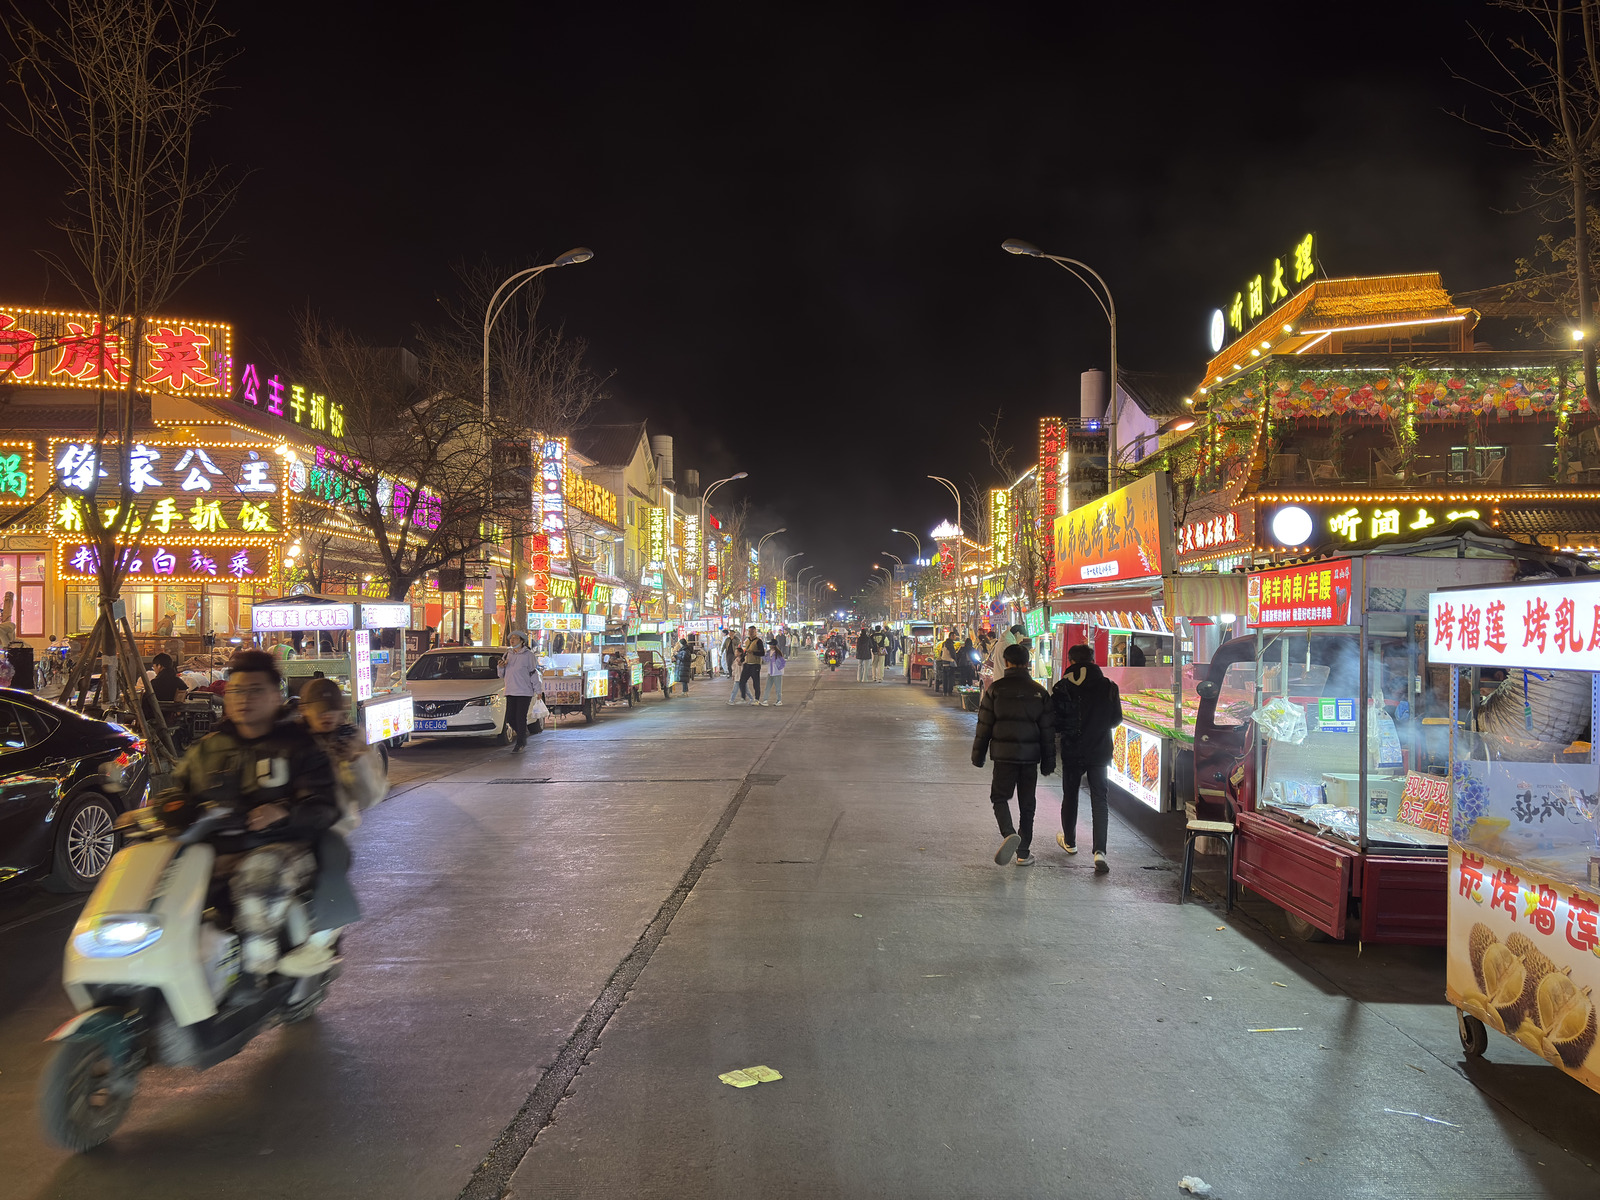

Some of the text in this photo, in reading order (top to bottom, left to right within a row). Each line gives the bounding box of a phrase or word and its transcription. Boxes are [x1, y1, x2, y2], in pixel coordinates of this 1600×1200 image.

[1230, 234, 1314, 333] 听闻大理
[0, 313, 219, 390] 白族菜
[57, 444, 277, 493] 傣家公主
[1329, 508, 1480, 542] 听闻大
[1261, 569, 1332, 605] 烤羊肉串/羊腰
[256, 610, 300, 628] 烤榴莲
[305, 608, 349, 627] 烤乳扇
[1434, 600, 1507, 653] 烤榴莲
[1405, 776, 1449, 804] 现切现
[1459, 850, 1600, 951] 炭烤榴莲
